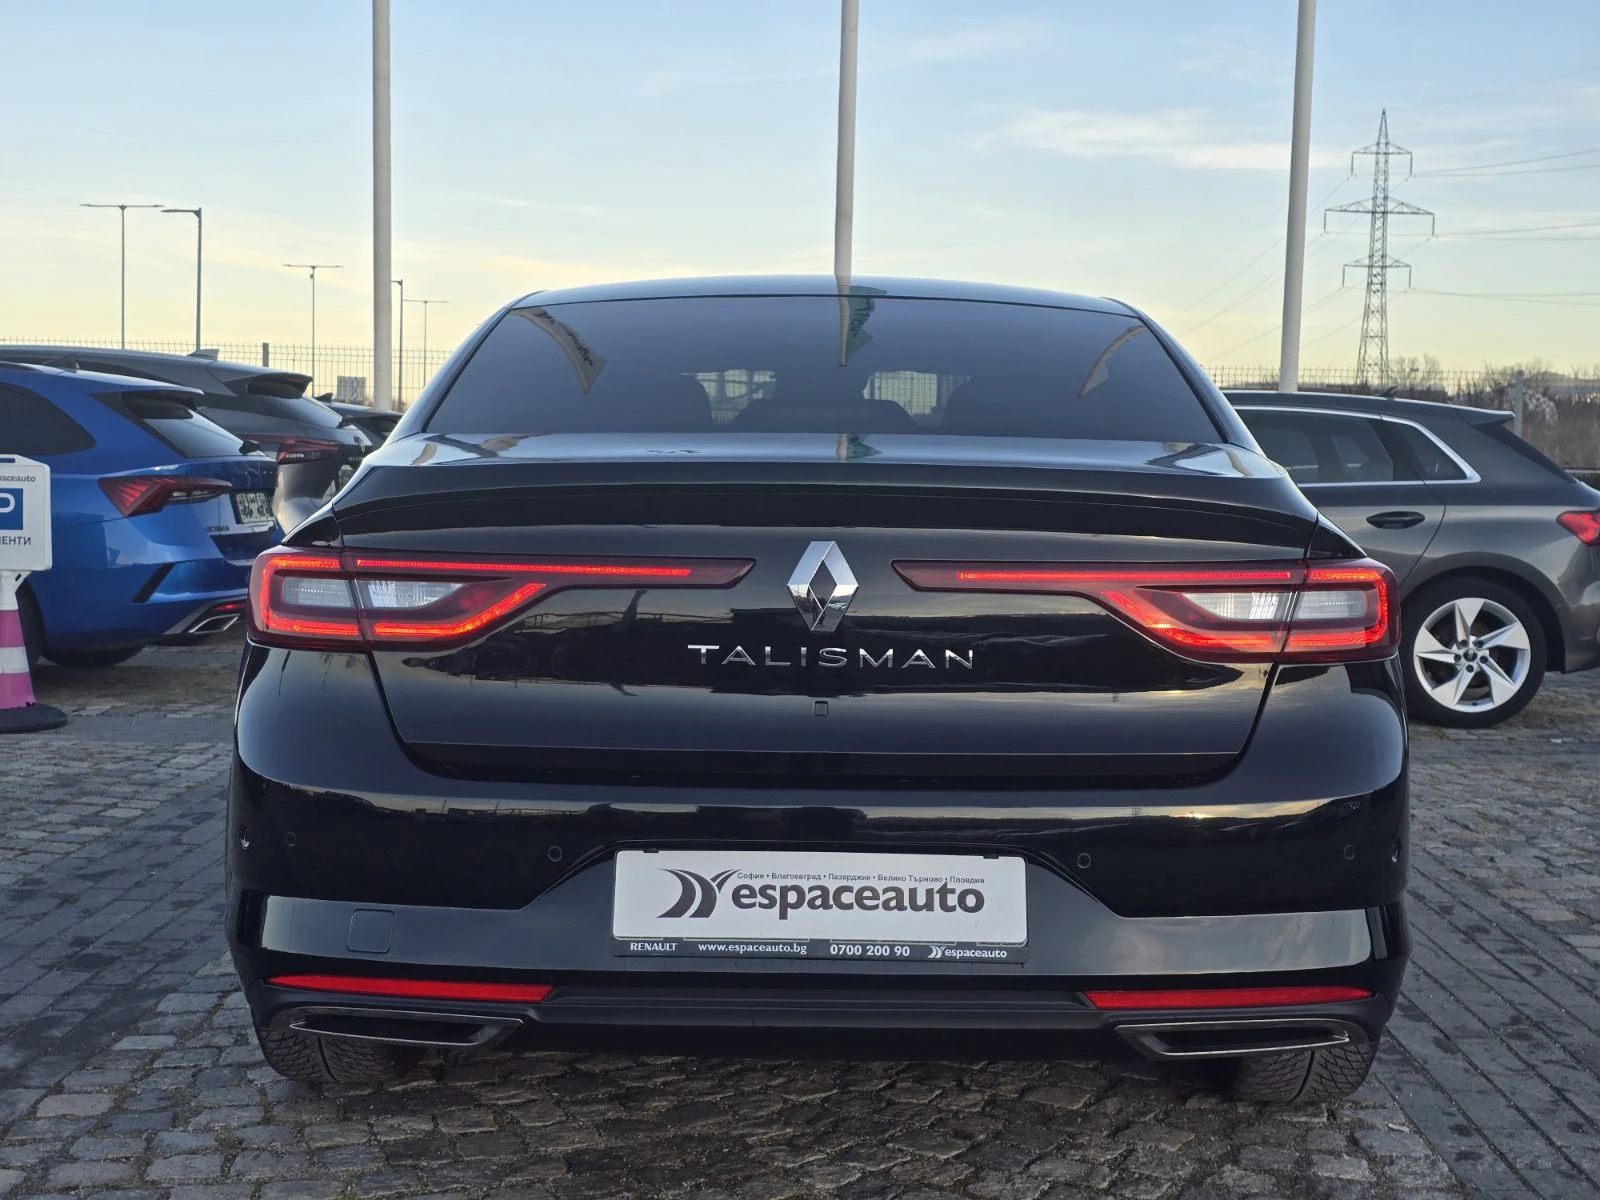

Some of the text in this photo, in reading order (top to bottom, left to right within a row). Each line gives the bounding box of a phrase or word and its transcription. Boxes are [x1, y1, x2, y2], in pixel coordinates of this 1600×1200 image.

[0, 474, 36, 482] aceauto
[0, 535, 32, 546] ЕНТИ
[687, 644, 974, 670] TALISMAN
[737, 872, 985, 884] София Благоевград Пазарджик Велико Търново Пловдив
[731, 881, 985, 920] espaceauto
[630, 942, 678, 951] RENAULT
[697, 943, 808, 955] www.espaceauto.bg
[830, 944, 911, 957] 0700 200 90
[944, 947, 1008, 960] espaceauto
